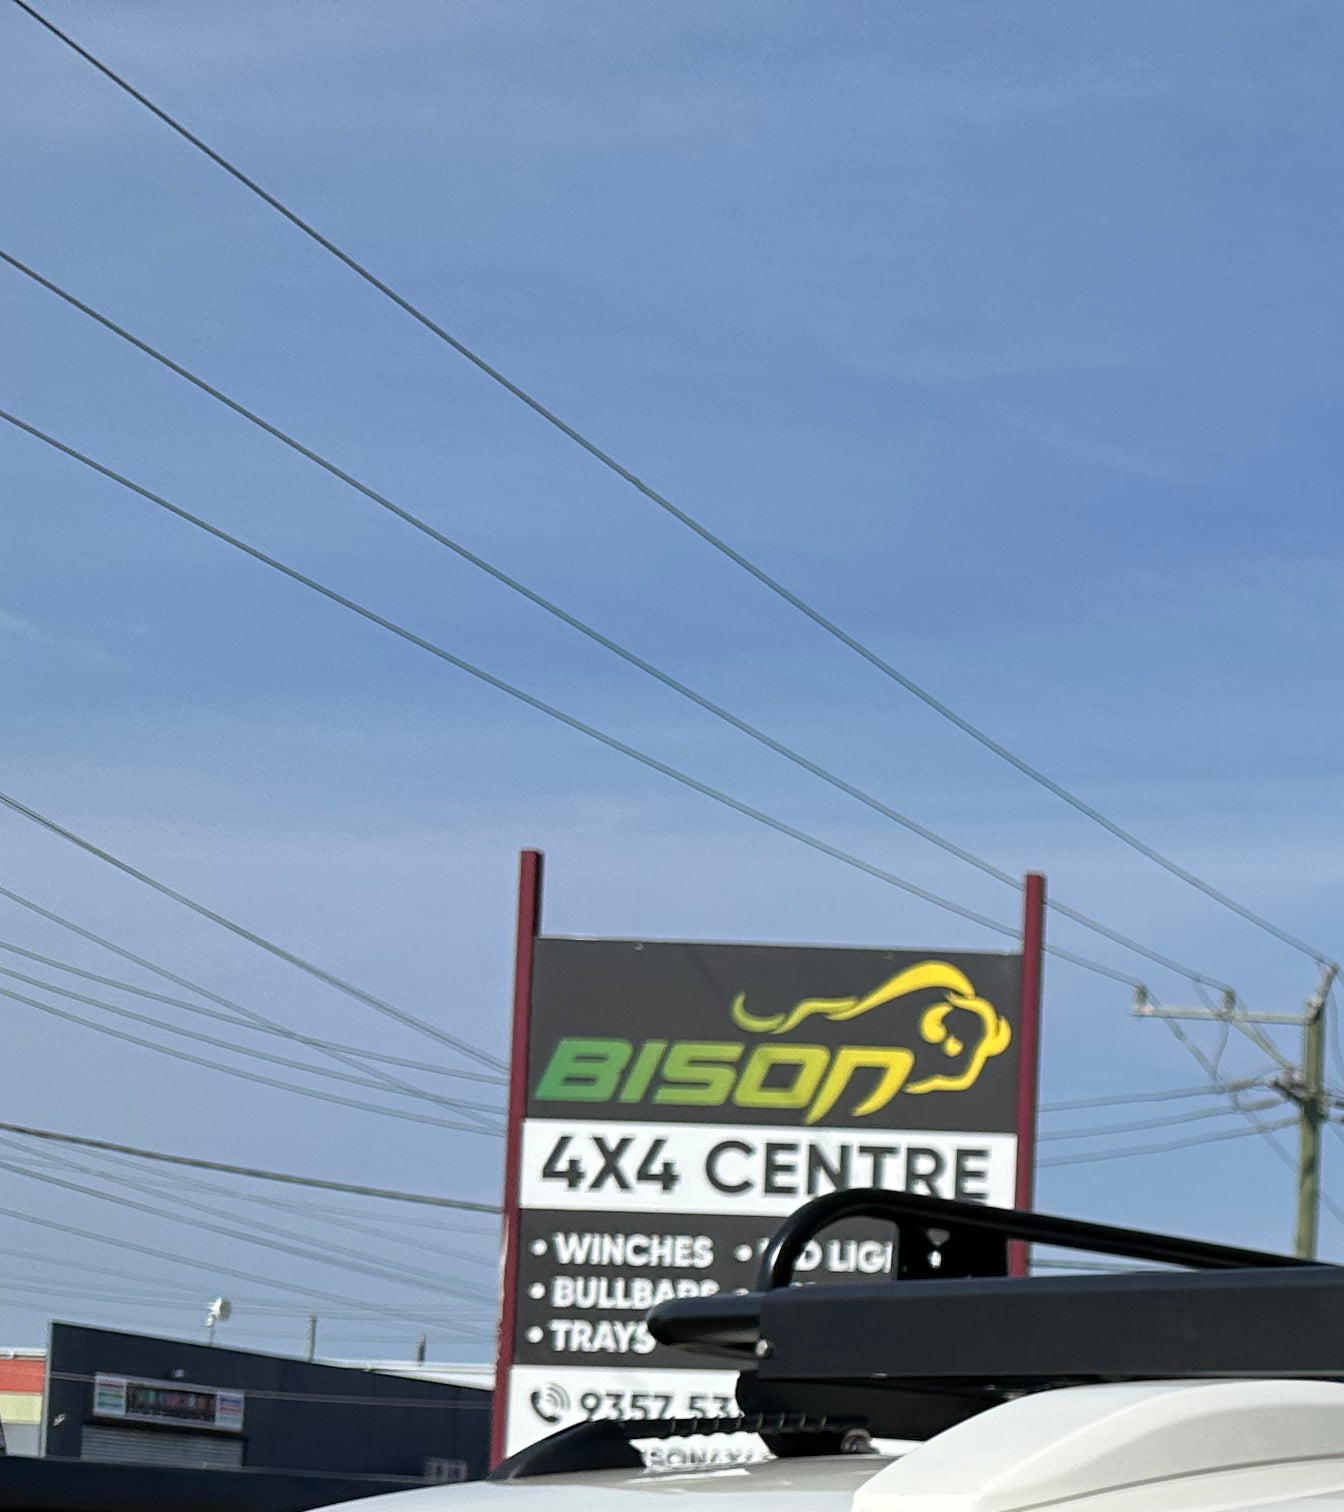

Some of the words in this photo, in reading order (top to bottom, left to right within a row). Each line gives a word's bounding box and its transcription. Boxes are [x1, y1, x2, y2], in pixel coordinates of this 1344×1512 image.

[542, 1136, 680, 1193] 4X4
[705, 1140, 989, 1200] CENTRE
[552, 1231, 714, 1268] WINCHES
[549, 1318, 656, 1354] TRAYS
